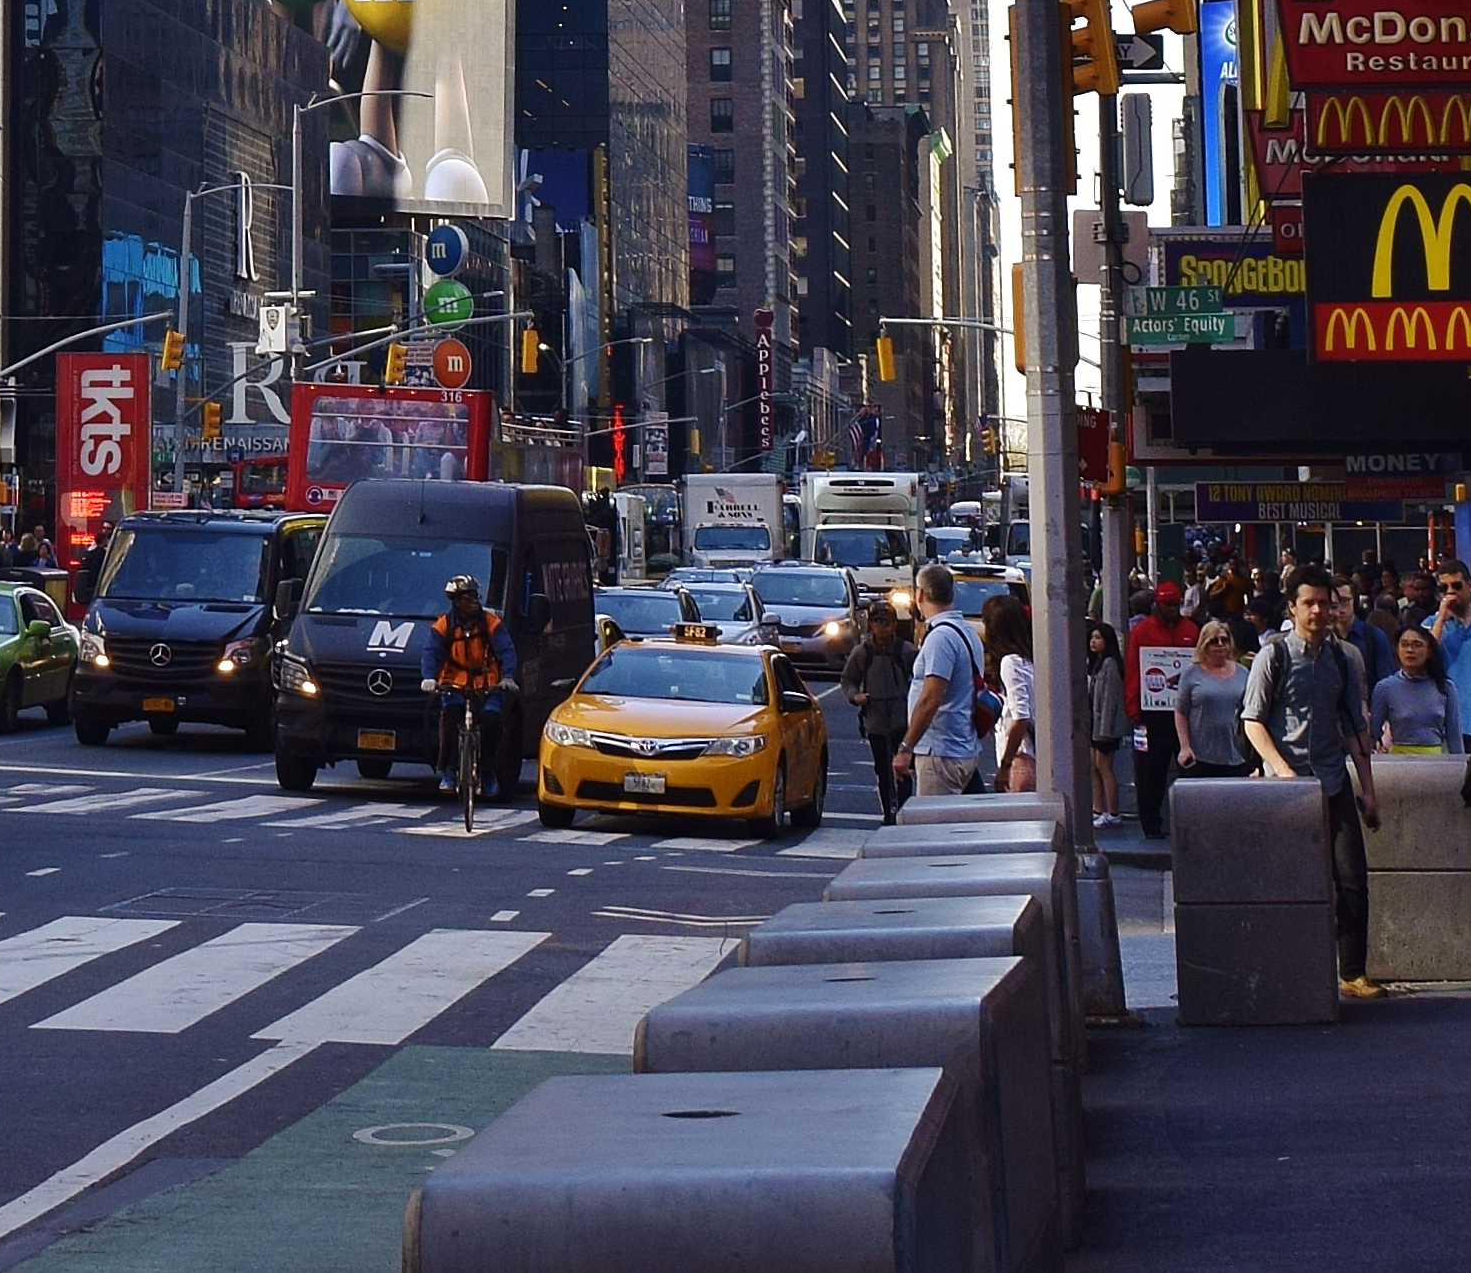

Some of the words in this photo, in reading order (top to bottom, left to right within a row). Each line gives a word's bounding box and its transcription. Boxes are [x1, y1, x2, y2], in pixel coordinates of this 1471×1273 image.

[1149, 292, 1169, 312] W
[1175, 289, 1200, 313] 46
[1131, 316, 1180, 334] Actors'
[1183, 316, 1226, 339] Equity
[440, 391, 464, 404] 316
[80, 364, 135, 477] tkts
[1345, 455, 1441, 472] MONEY
[1259, 502, 1286, 520] BEST
[1288, 502, 1343, 521] MUSICAL
